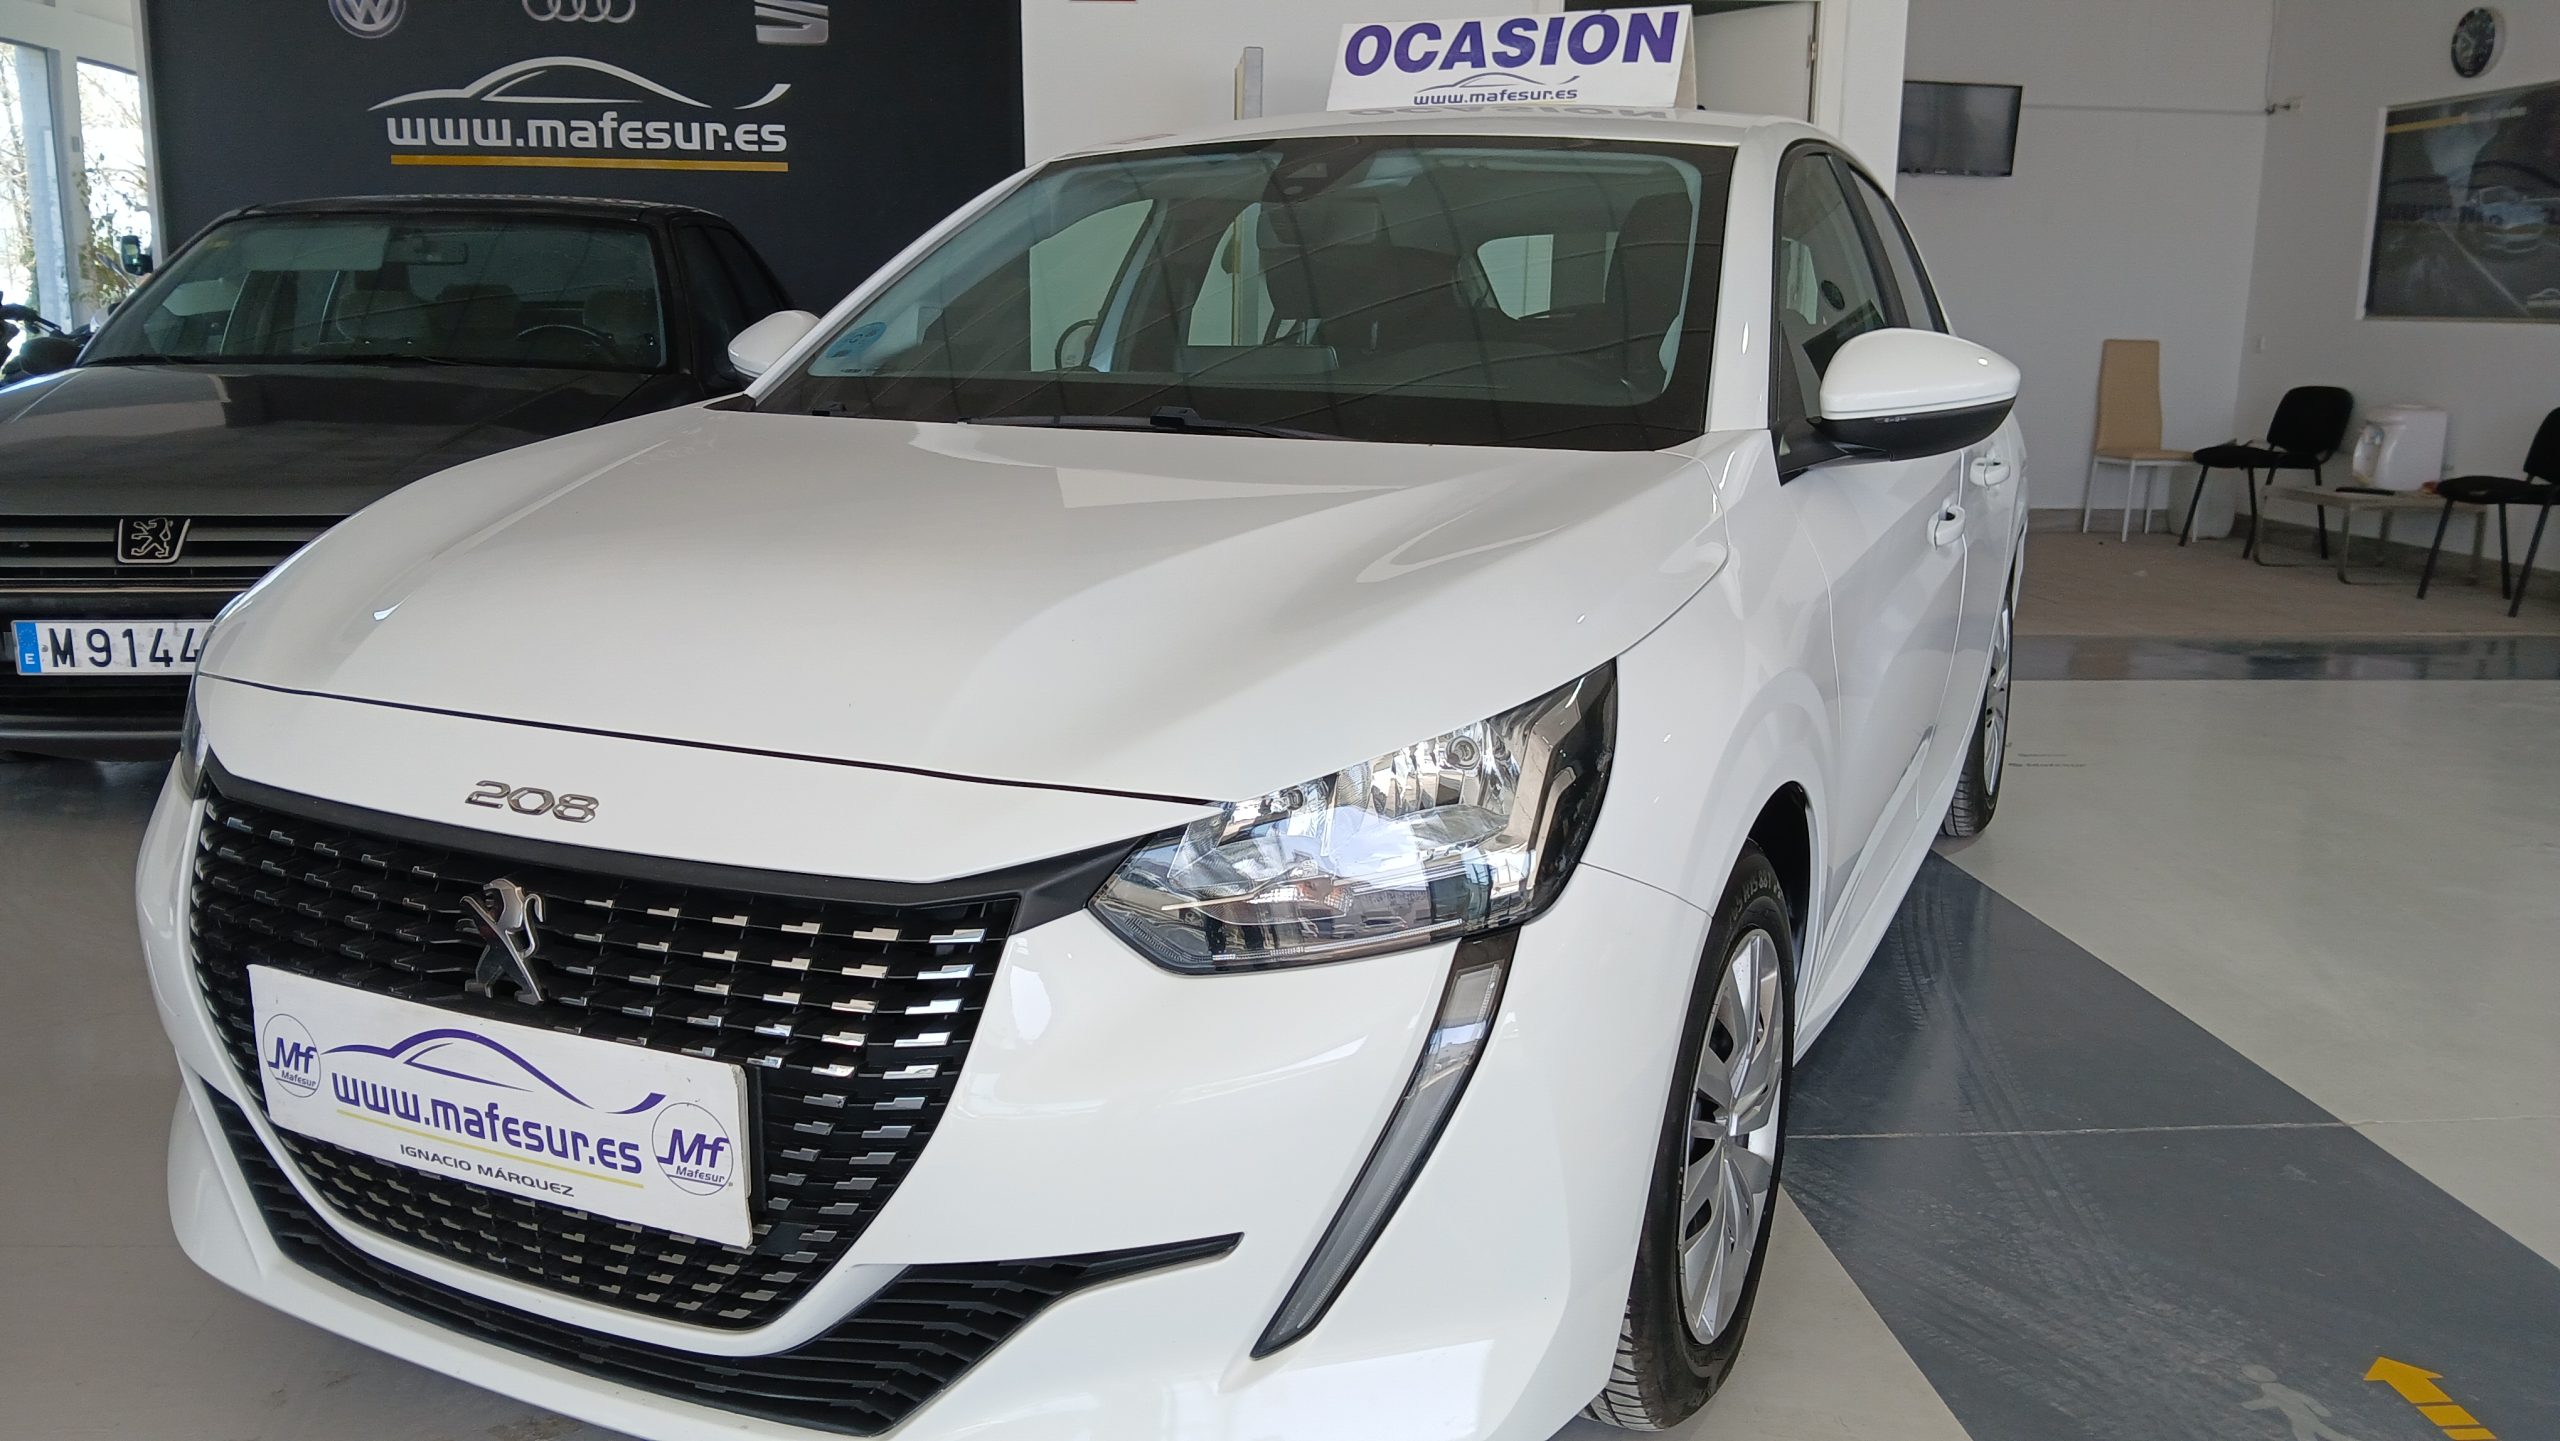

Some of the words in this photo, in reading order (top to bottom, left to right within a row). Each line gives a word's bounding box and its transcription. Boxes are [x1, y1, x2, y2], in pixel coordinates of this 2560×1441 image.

[1413, 88, 1579, 106] www.mafesur.es
[386, 111, 788, 152] www.mafesur.es
[25, 653, 35, 665] E
[465, 780, 600, 824] 208
[281, 1070, 317, 1088] Mafesur
[331, 1072, 643, 1174] www.mafesur.es
[400, 1144, 472, 1172] IGNACIO
[477, 1163, 575, 1198] MÁRQUEZ
[675, 1165, 726, 1184] Mafesur
